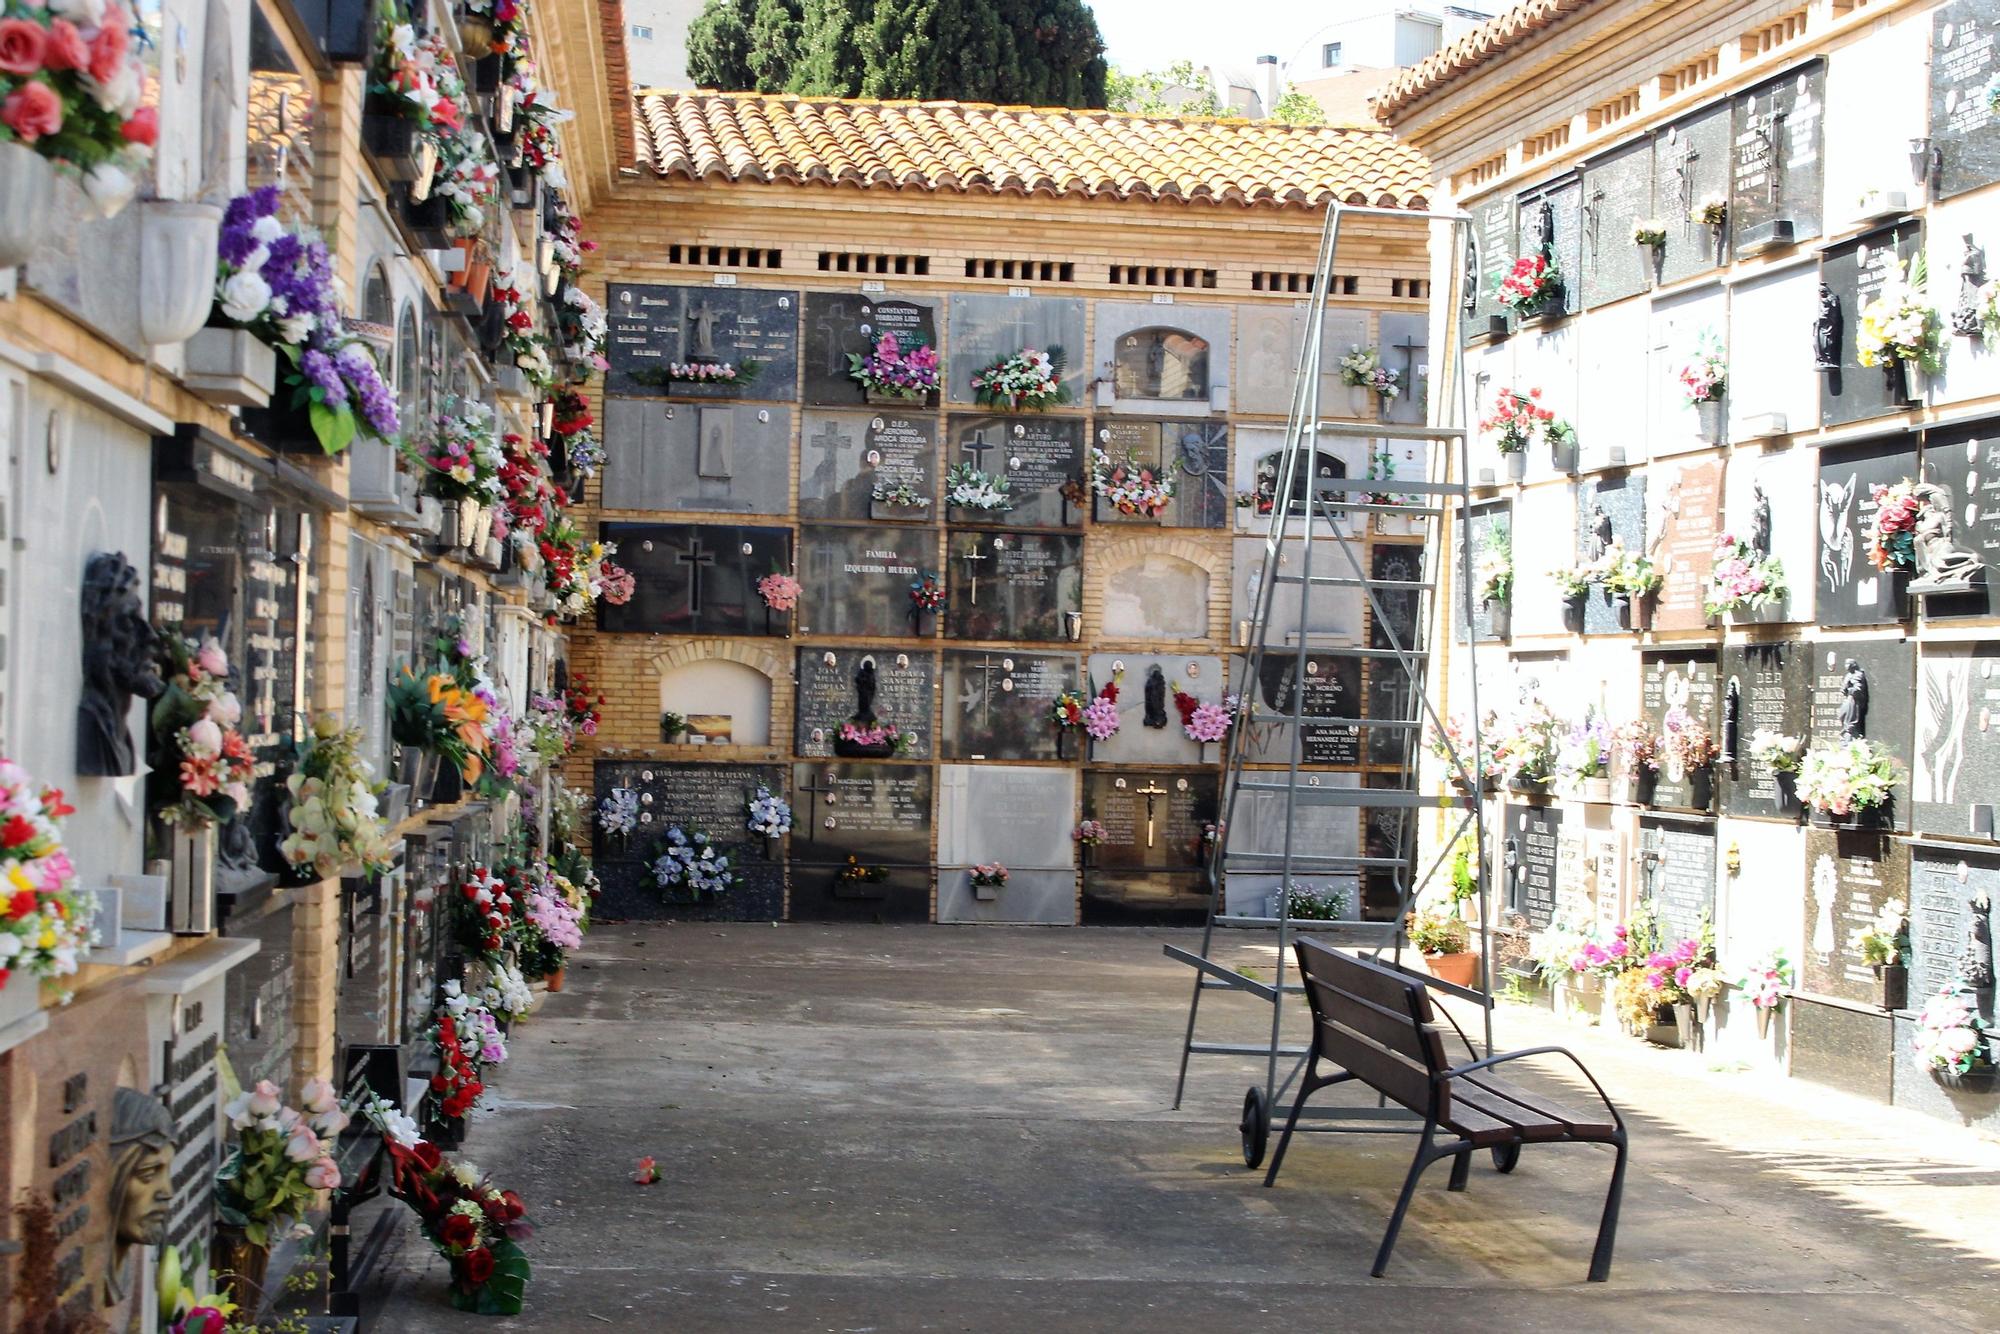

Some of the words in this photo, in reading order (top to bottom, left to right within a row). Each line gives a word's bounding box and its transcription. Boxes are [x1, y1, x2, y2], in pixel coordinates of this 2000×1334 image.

[877, 307, 918, 315] CONSTANTINO
[899, 436, 926, 444] SEGURA
[865, 550, 897, 559] FAMILIA
[844, 564, 886, 574] IZQUIERDO
[888, 565, 918, 575] HUERTA
